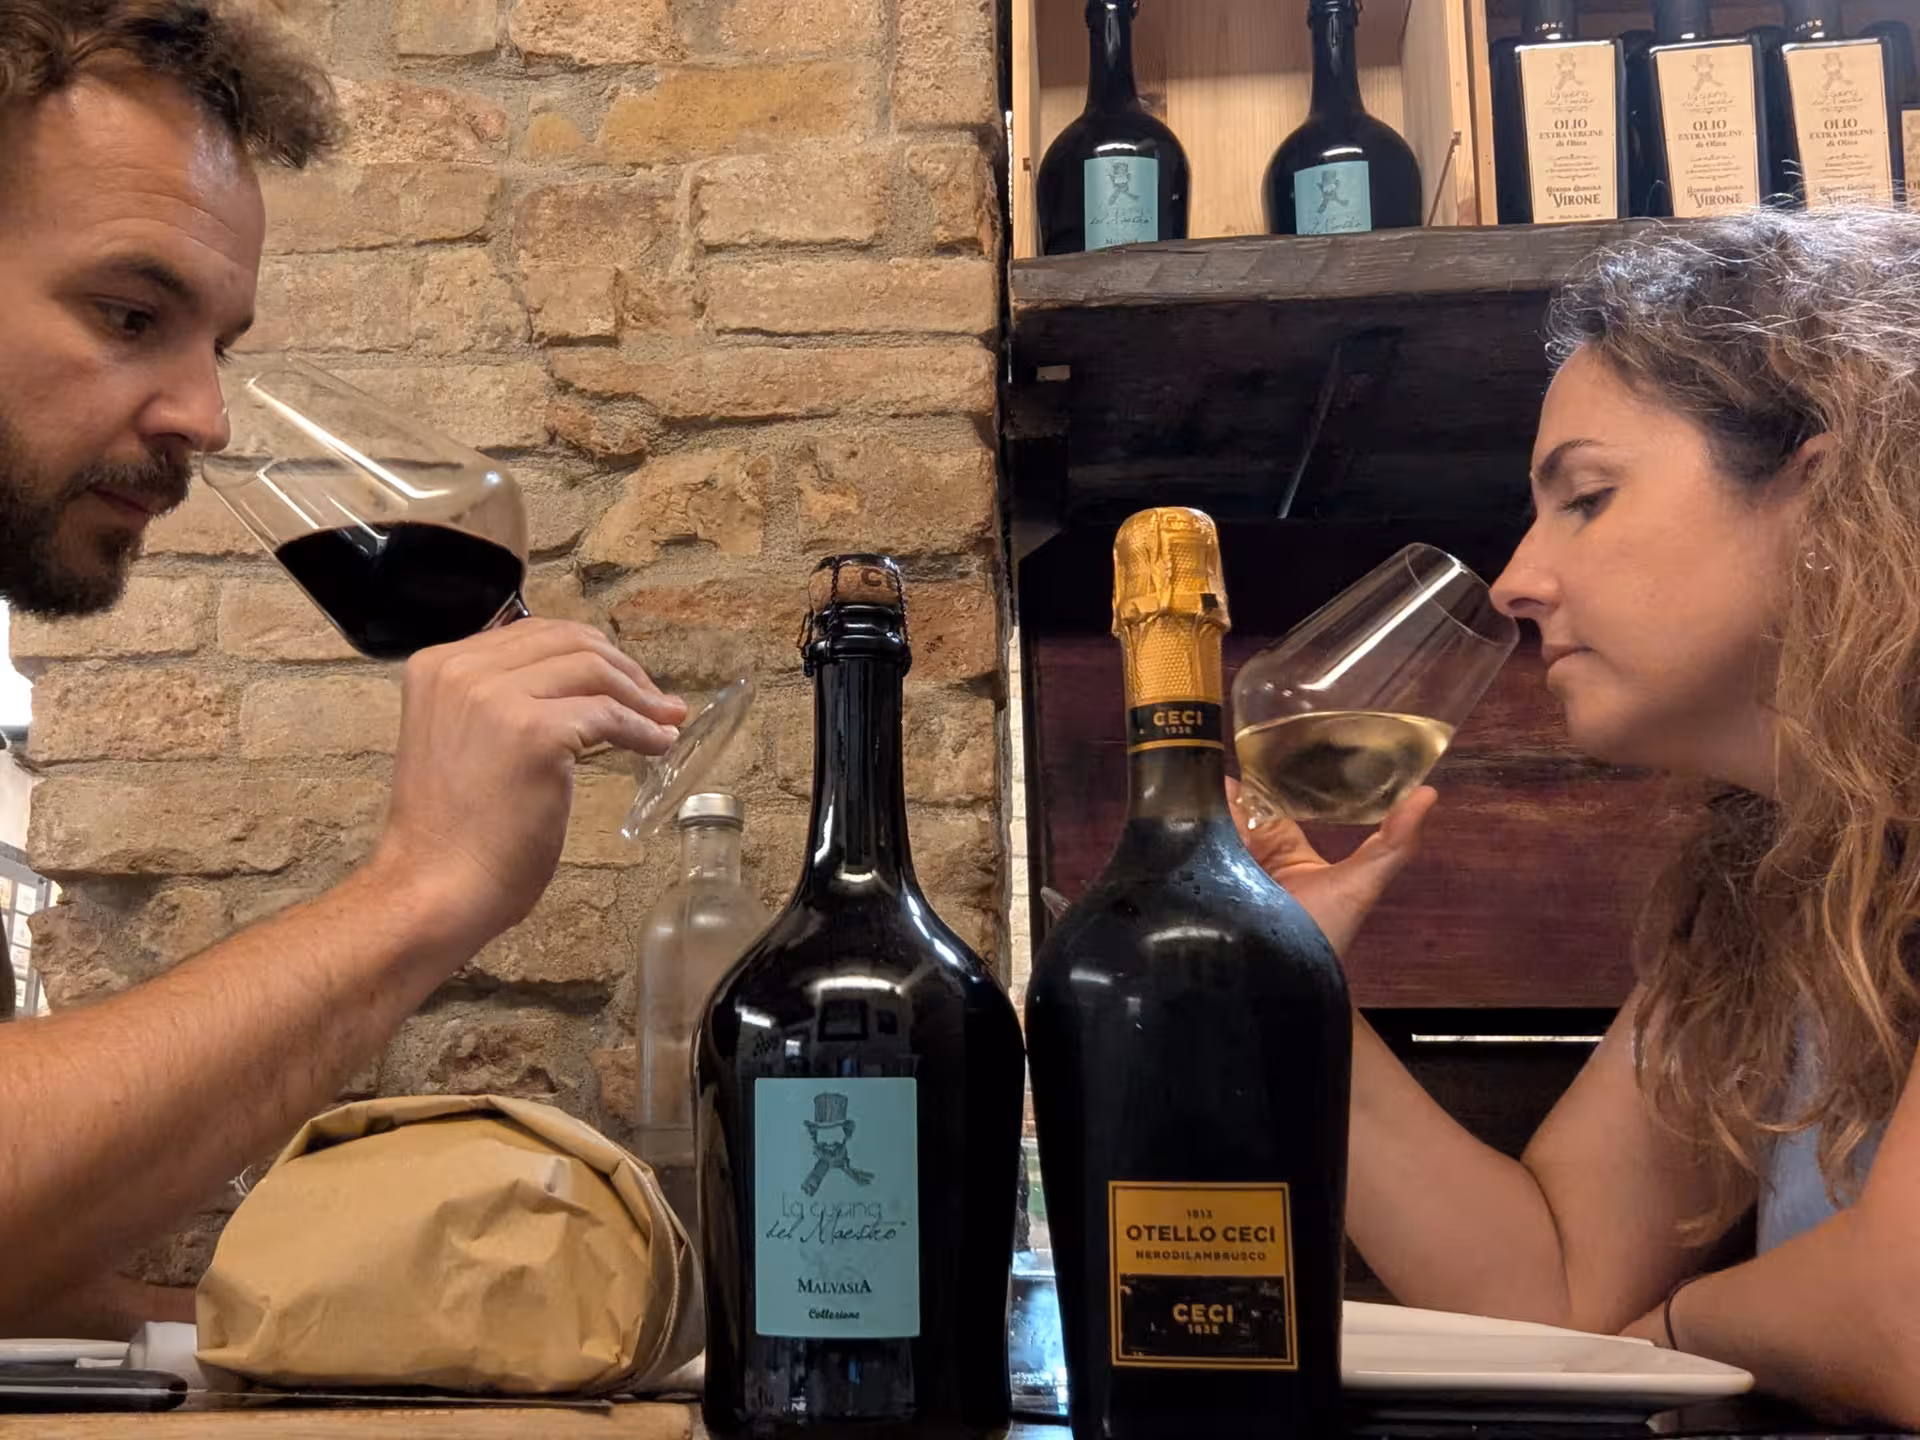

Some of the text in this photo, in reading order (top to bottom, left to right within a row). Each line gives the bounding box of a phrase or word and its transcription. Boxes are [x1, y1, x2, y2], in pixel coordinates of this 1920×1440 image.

[1554, 119, 1588, 130] OLIO
[1693, 120, 1727, 131] OLIO
[1824, 118, 1858, 130] OLIO
[1539, 130, 1604, 140] EXTRA VERGINE
[1549, 193, 1601, 208] VIRONE
[1690, 193, 1743, 208] VIRONE
[1153, 711, 1203, 727] CECI
[1126, 1225, 1276, 1243] OTELLO CECI
[1136, 1250, 1267, 1261] NERODILAMBRUSCO
[797, 1278, 872, 1295] MALVASIA
[1172, 1303, 1234, 1323] CECI
